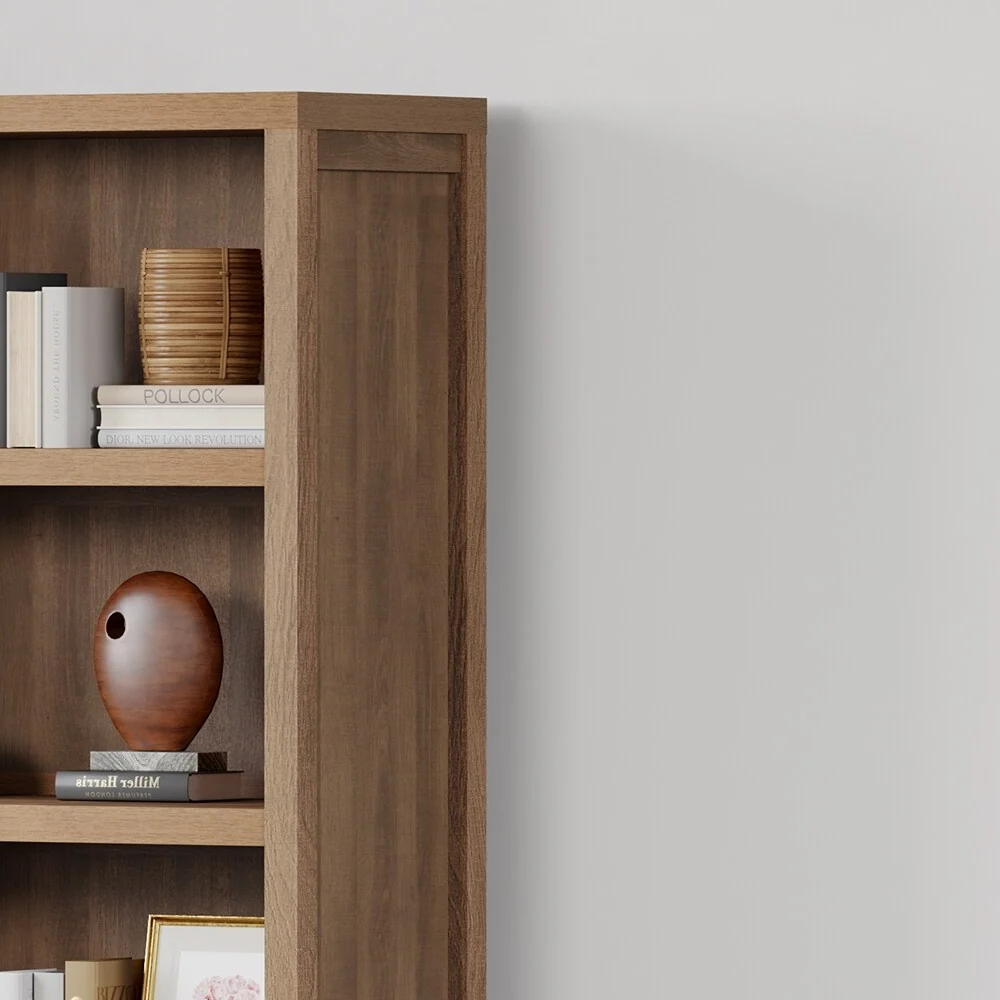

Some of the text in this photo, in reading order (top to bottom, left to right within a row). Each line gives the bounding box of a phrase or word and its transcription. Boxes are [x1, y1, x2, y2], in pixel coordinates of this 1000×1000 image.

[144, 388, 225, 404] POLLOCK
[137, 434, 161, 445] NEW
[163, 434, 192, 445] LOOK
[195, 434, 262, 445] REVOLUTION
